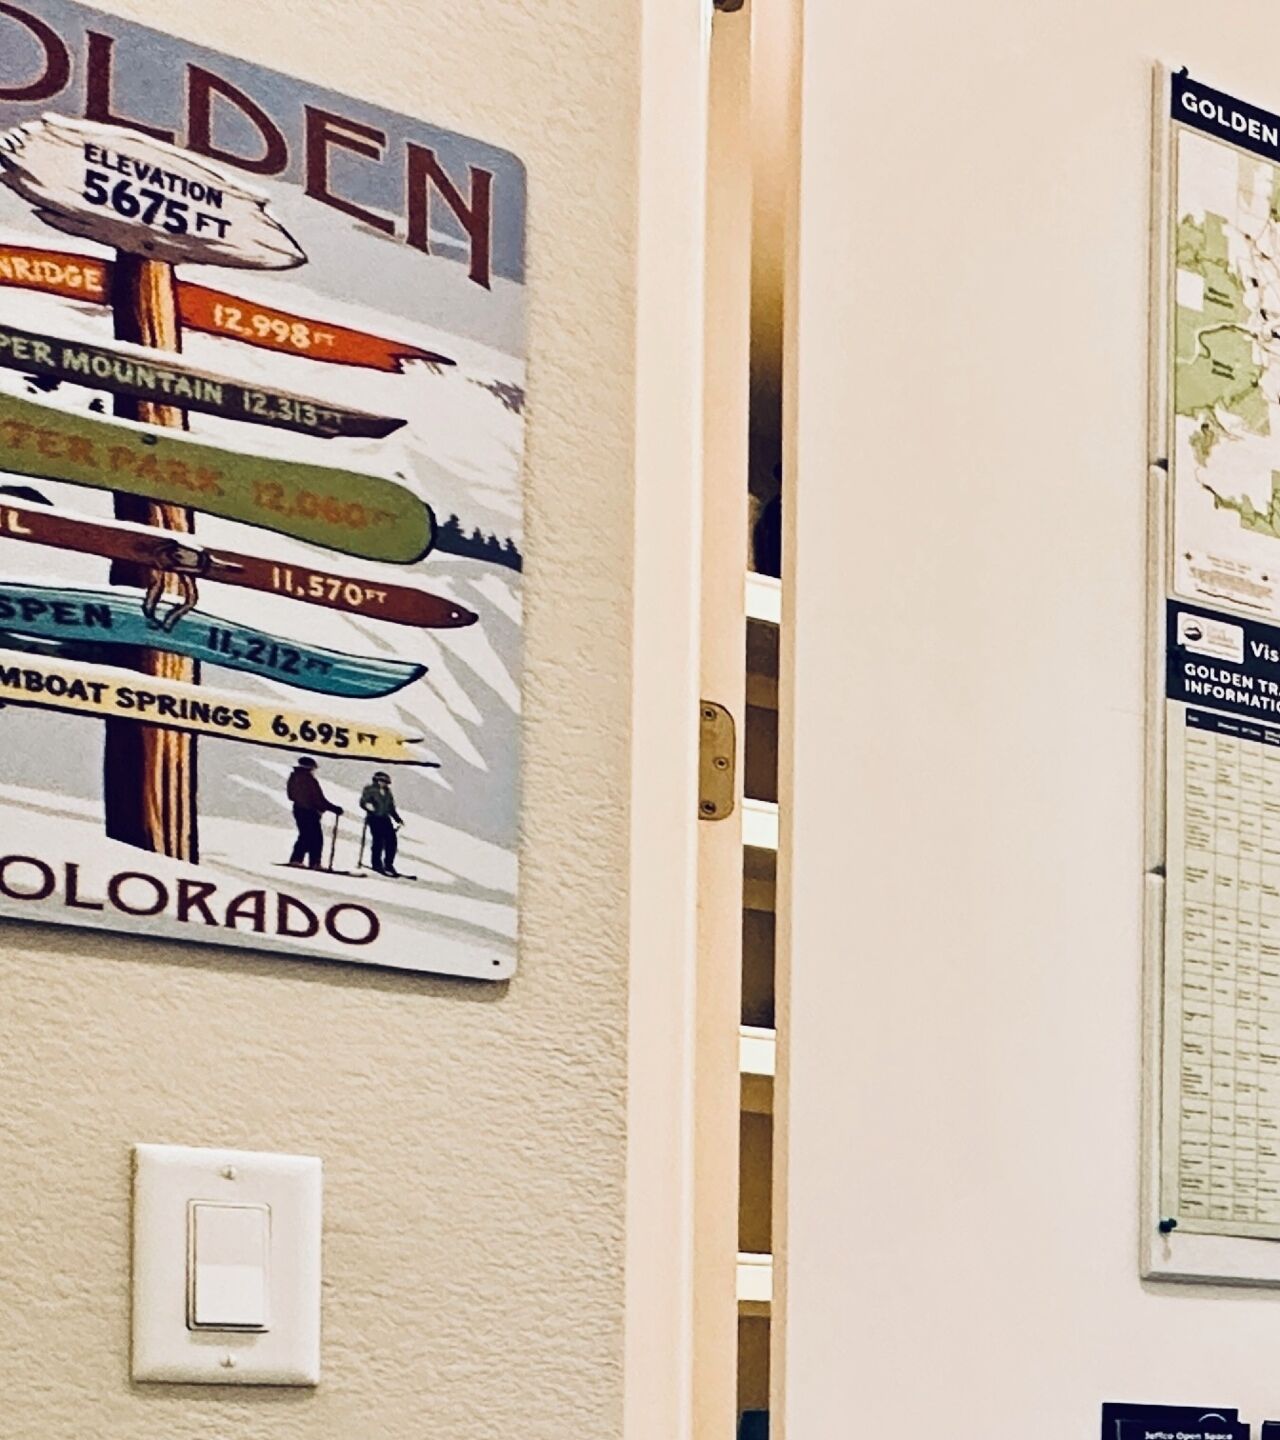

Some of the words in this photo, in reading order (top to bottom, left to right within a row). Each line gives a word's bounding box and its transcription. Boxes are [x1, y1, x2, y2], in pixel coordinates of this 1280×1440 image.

[1181, 91, 1279, 147] GOLDEN
[82, 169, 189, 235] 5675
[196, 212, 232, 239] FT
[84, 143, 223, 208] ELEVATION
[213, 303, 309, 349] 12,998
[62, 349, 223, 404] MOUNTAIN
[242, 390, 317, 427] 12,313
[0, 509, 32, 534] L
[270, 566, 364, 606] 11,570
[365, 590, 388, 604] FT
[205, 627, 299, 677] 11,212
[1184, 663, 1254, 689] GOLDEN
[116, 687, 252, 731] SPRINGS
[271, 715, 351, 749] 6,695
[356, 732, 379, 747] FT
